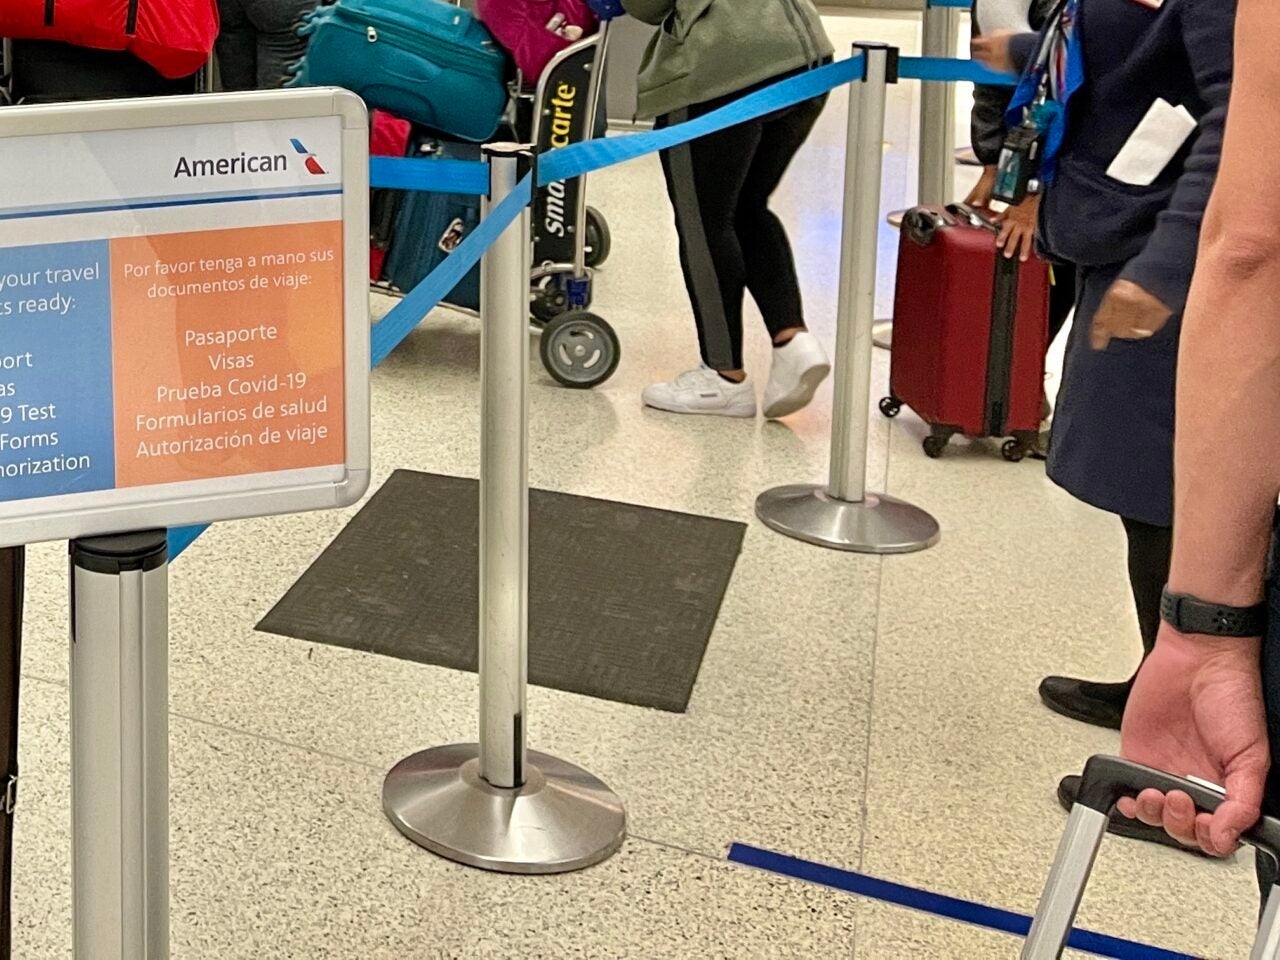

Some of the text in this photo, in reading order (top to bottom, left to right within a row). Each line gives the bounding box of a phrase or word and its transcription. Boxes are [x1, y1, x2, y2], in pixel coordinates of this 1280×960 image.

[174, 152, 287, 178] American
[45, 262, 100, 284] travel
[123, 248, 335, 278] Por favor tenga a mano sus
[147, 272, 313, 299] documentos de viaje:
[18, 292, 76, 315] ready:
[185, 325, 278, 348] Pasaporte
[208, 353, 255, 371] Visas
[157, 372, 307, 402] Prueba Covid-19
[18, 402, 57, 421] Test
[136, 395, 328, 431] Formularios de salud
[0, 431, 59, 451] Forms
[136, 422, 328, 458] Autorización de viaje
